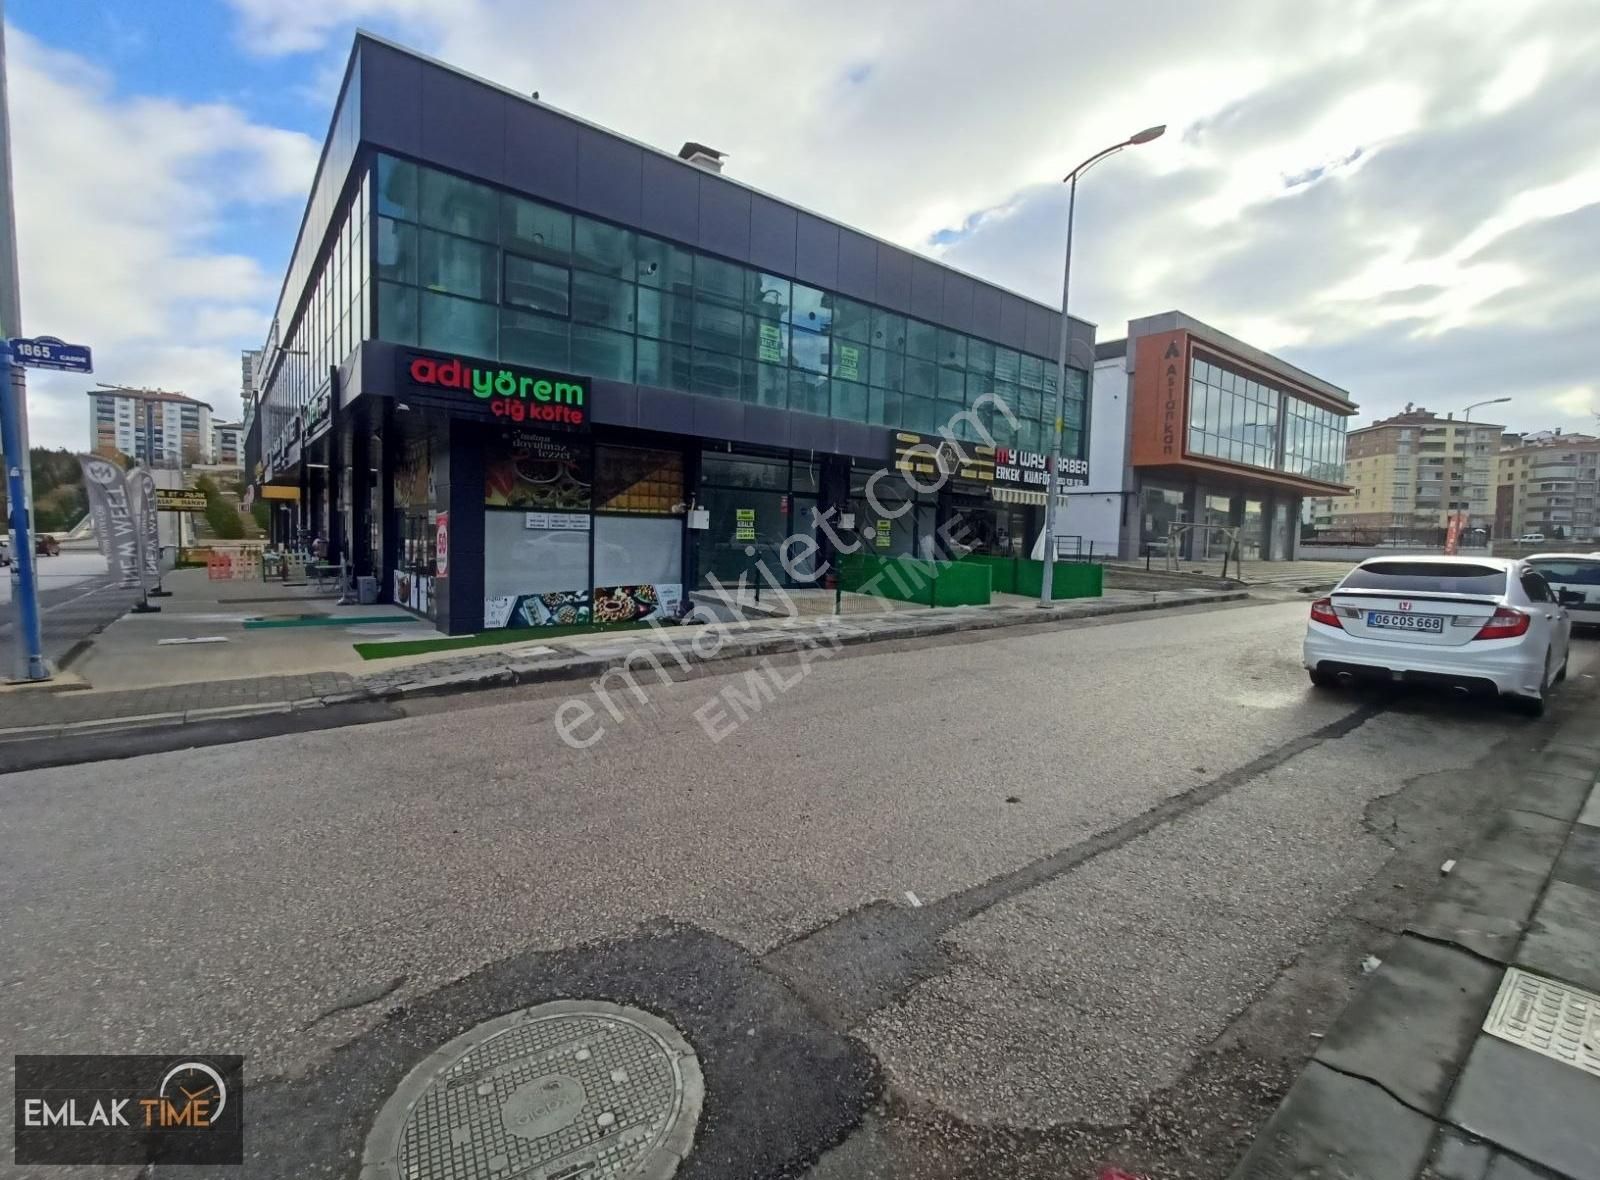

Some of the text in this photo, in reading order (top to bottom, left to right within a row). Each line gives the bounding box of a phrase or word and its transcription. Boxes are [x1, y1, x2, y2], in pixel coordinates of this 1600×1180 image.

[530, 401, 583, 424] köfte
[1020, 450, 1046, 469] WAY
[996, 466, 1020, 482] ERKEK
[1375, 615, 1390, 625] 06
[1416, 618, 1440, 629] 668
